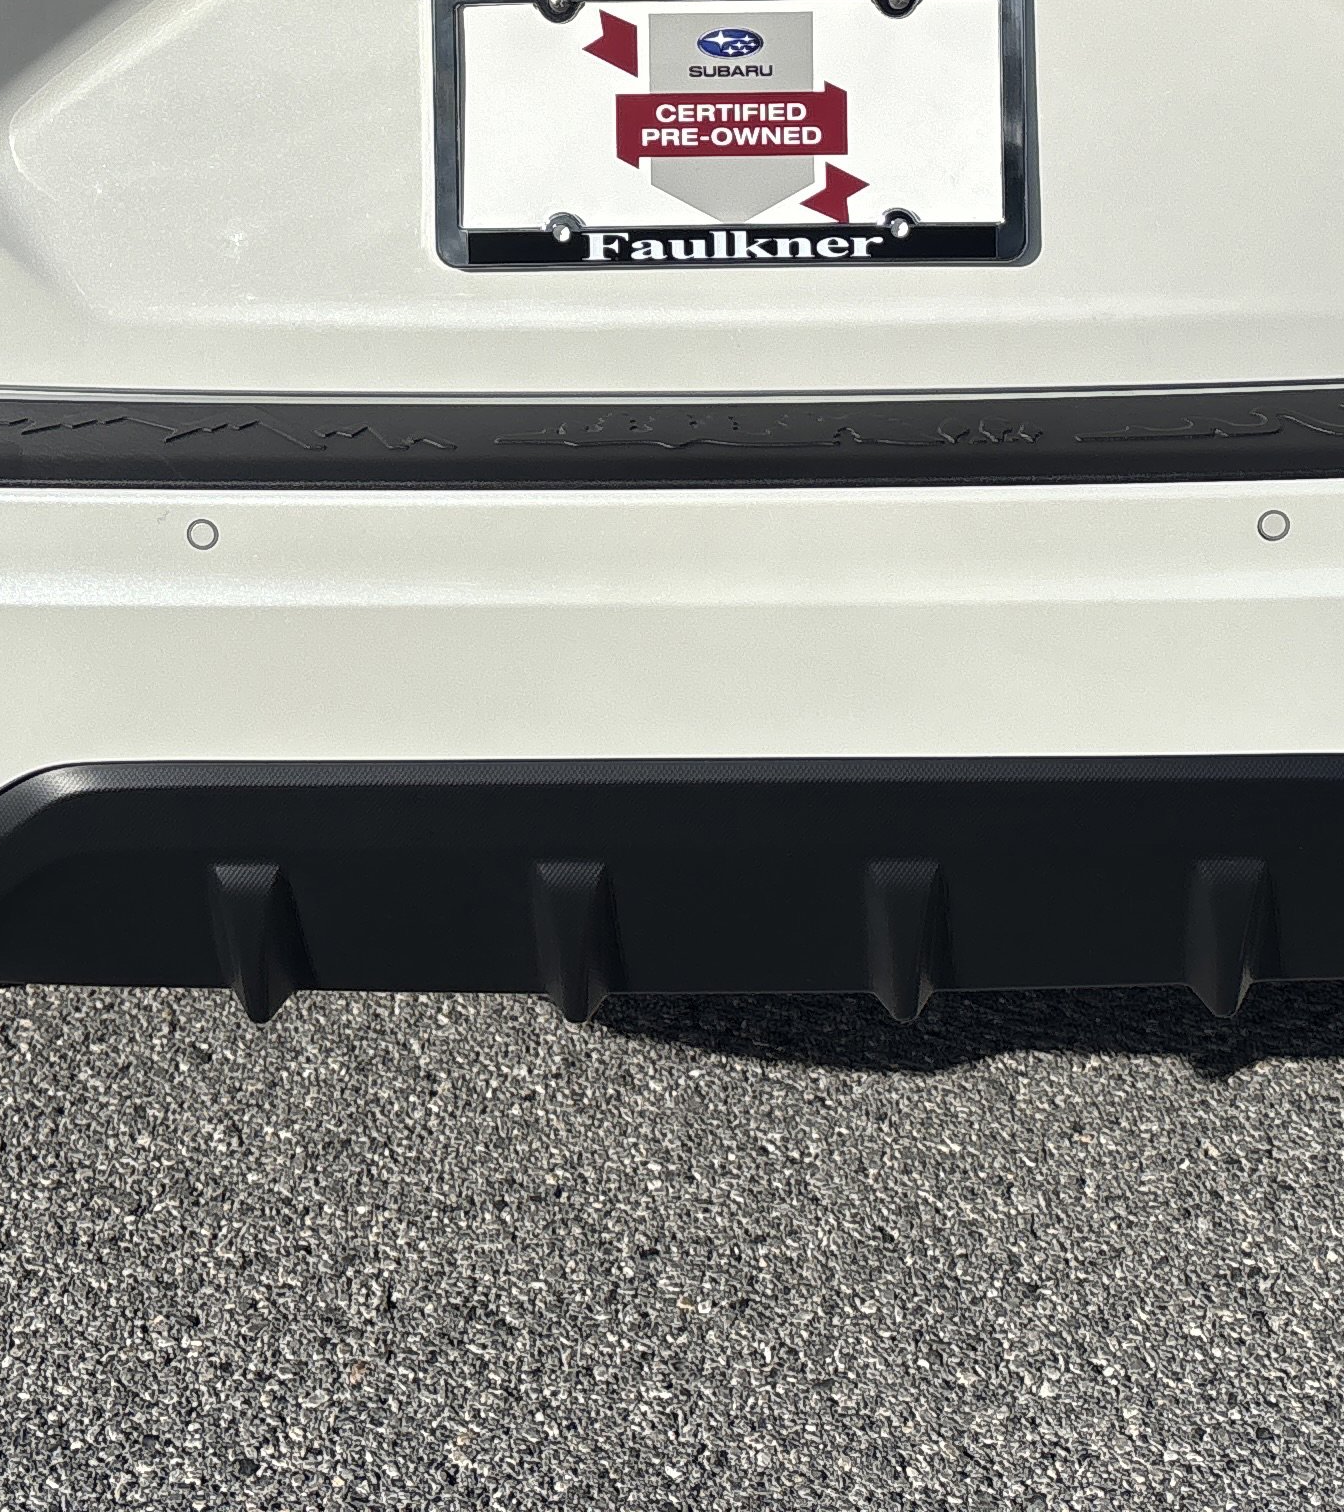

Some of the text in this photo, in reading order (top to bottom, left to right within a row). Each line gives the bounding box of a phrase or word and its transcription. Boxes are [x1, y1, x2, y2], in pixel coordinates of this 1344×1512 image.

[688, 65, 773, 78] SUBARU
[655, 102, 807, 124] CERTIFIED
[641, 126, 823, 148] PRE-OWNED
[584, 231, 884, 262] Faulkner
